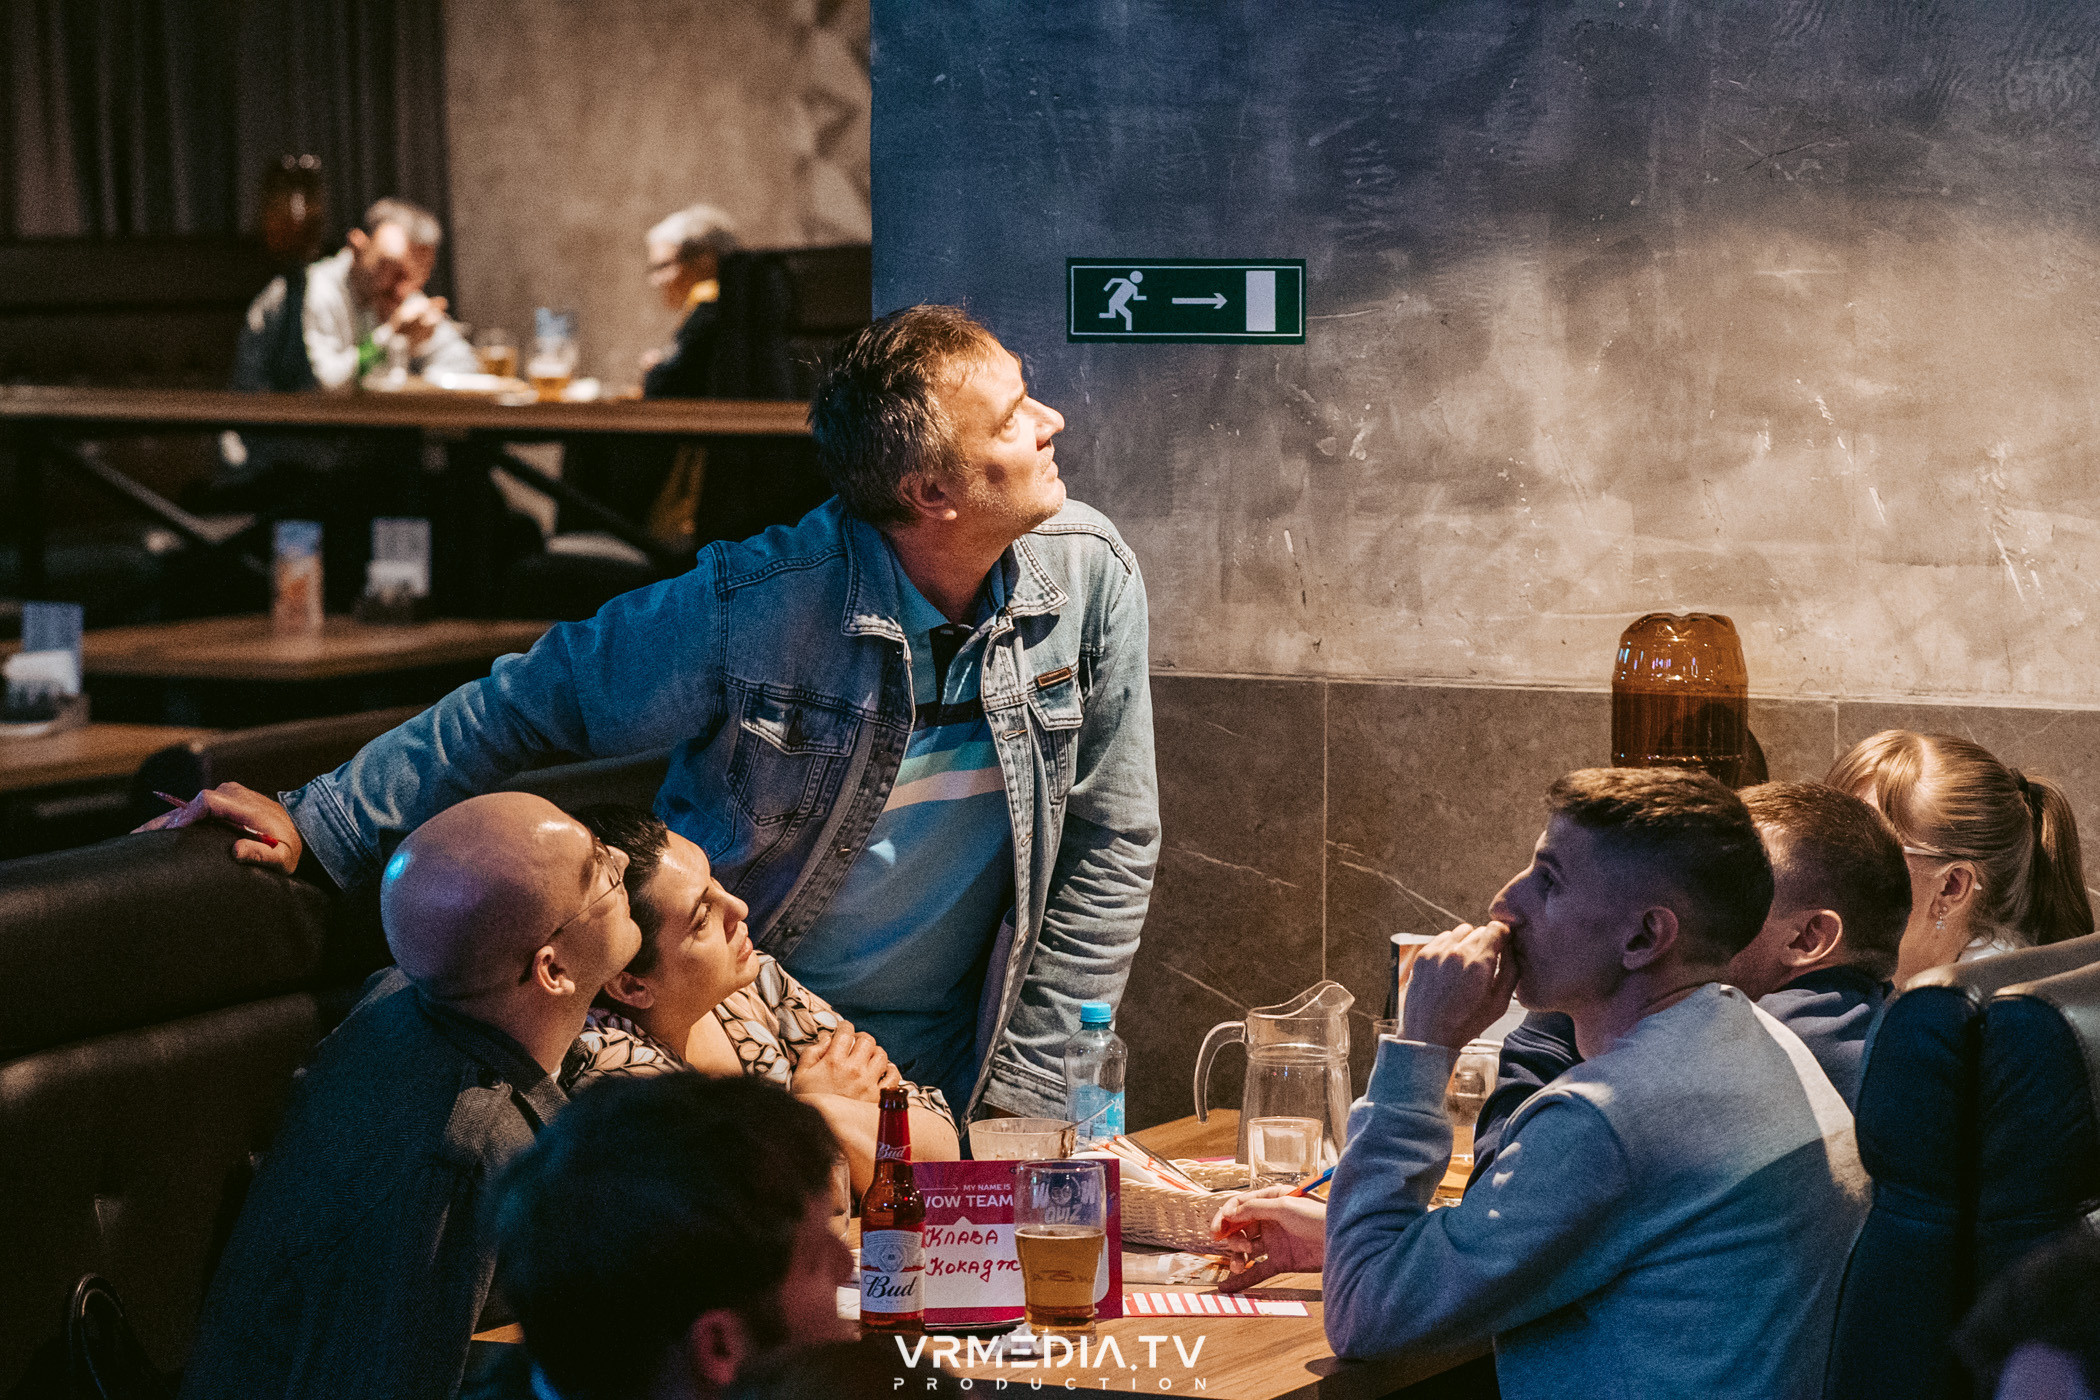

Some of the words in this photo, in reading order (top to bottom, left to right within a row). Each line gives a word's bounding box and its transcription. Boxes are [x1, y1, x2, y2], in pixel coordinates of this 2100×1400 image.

[878, 1141, 906, 1158] Bud
[978, 1183, 1002, 1191] NAME
[966, 1194, 1014, 1208] TEAM
[864, 1274, 918, 1298] Bud
